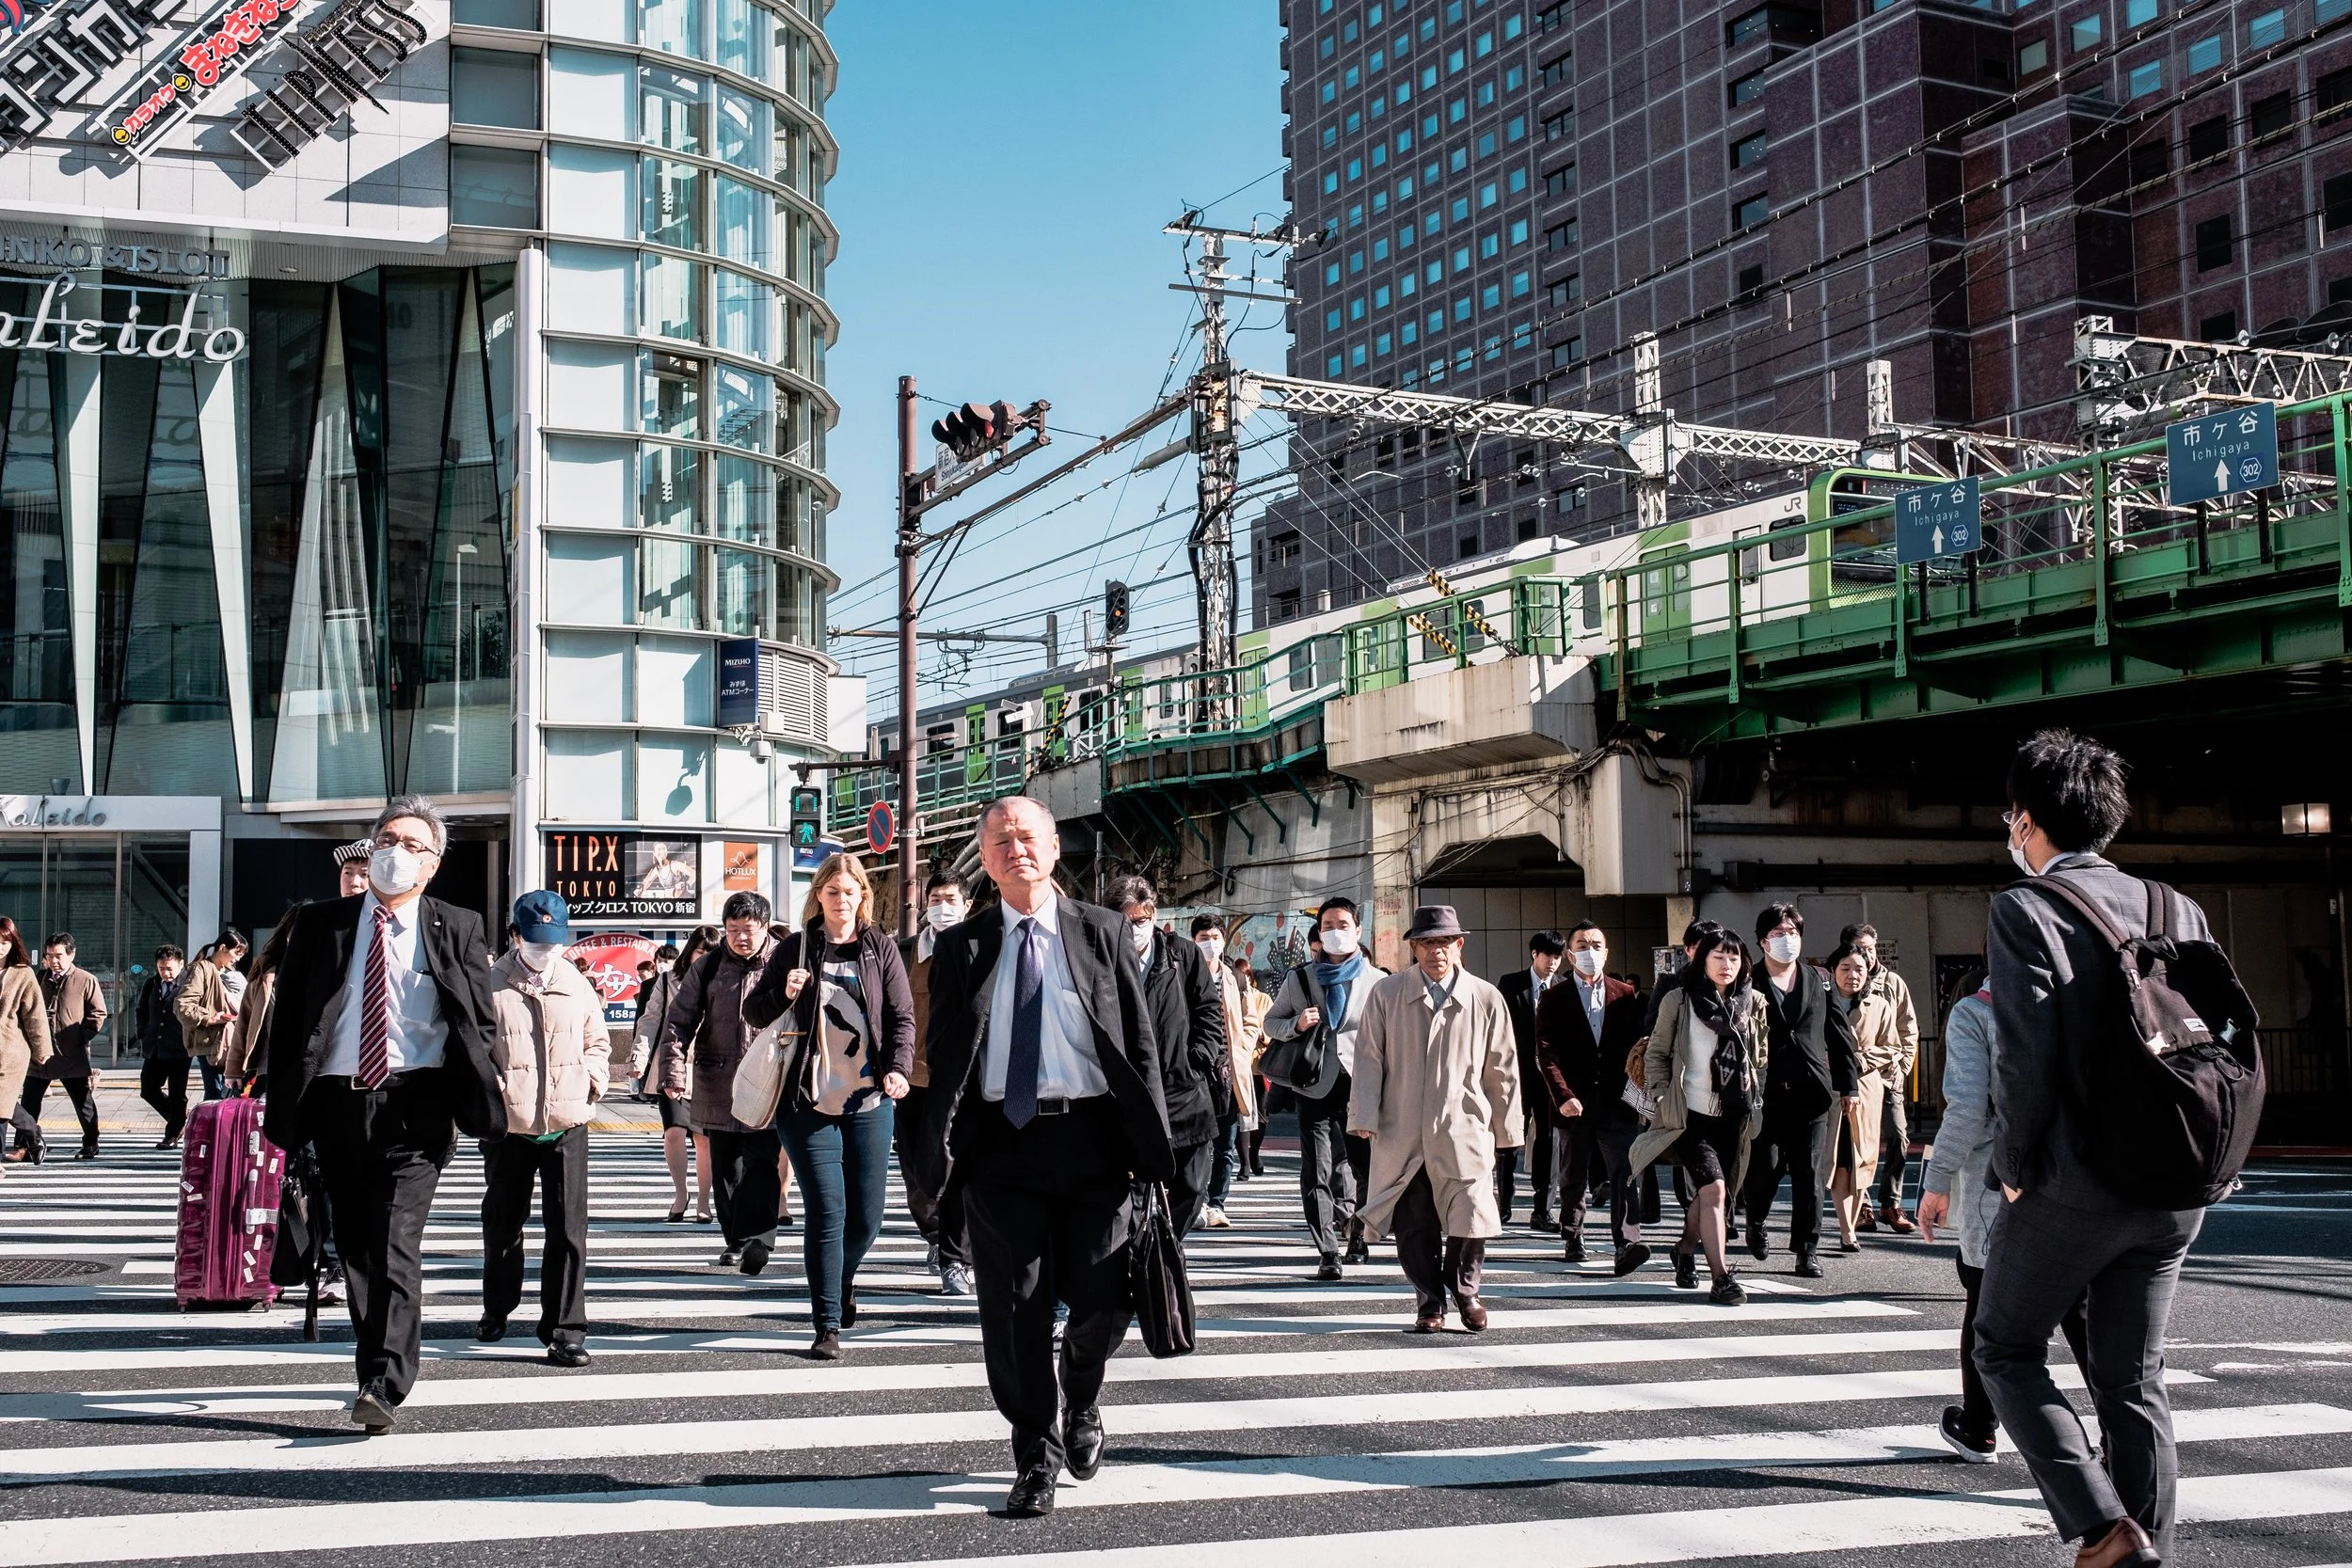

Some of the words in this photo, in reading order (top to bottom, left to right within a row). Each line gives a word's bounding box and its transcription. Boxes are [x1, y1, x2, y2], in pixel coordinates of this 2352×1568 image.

[179, 0, 298, 86] まねきね
[241, 0, 427, 159] TIPNESS
[122, 83, 177, 134] カラオケ
[102, 244, 127, 269] &
[139, 248, 230, 277] SLOT
[2192, 440, 2249, 462] Ichigaya
[2243, 463, 2259, 477] 302
[1784, 497, 1801, 513] JR
[1915, 510, 1960, 526] Ichigaya
[1953, 530, 1966, 542] 302
[725, 657, 750, 666] MIZUHO
[722, 688, 754, 696] ATMコーナー
[553, 835, 619, 872] TIP.X
[724, 867, 756, 877] HOTLUX
[556, 880, 616, 897] TOKYO
[629, 901, 674, 914] TOKYO
[675, 901, 696, 914] 新宿
[564, 939, 598, 959] OFFEE
[600, 937, 608, 948] &
